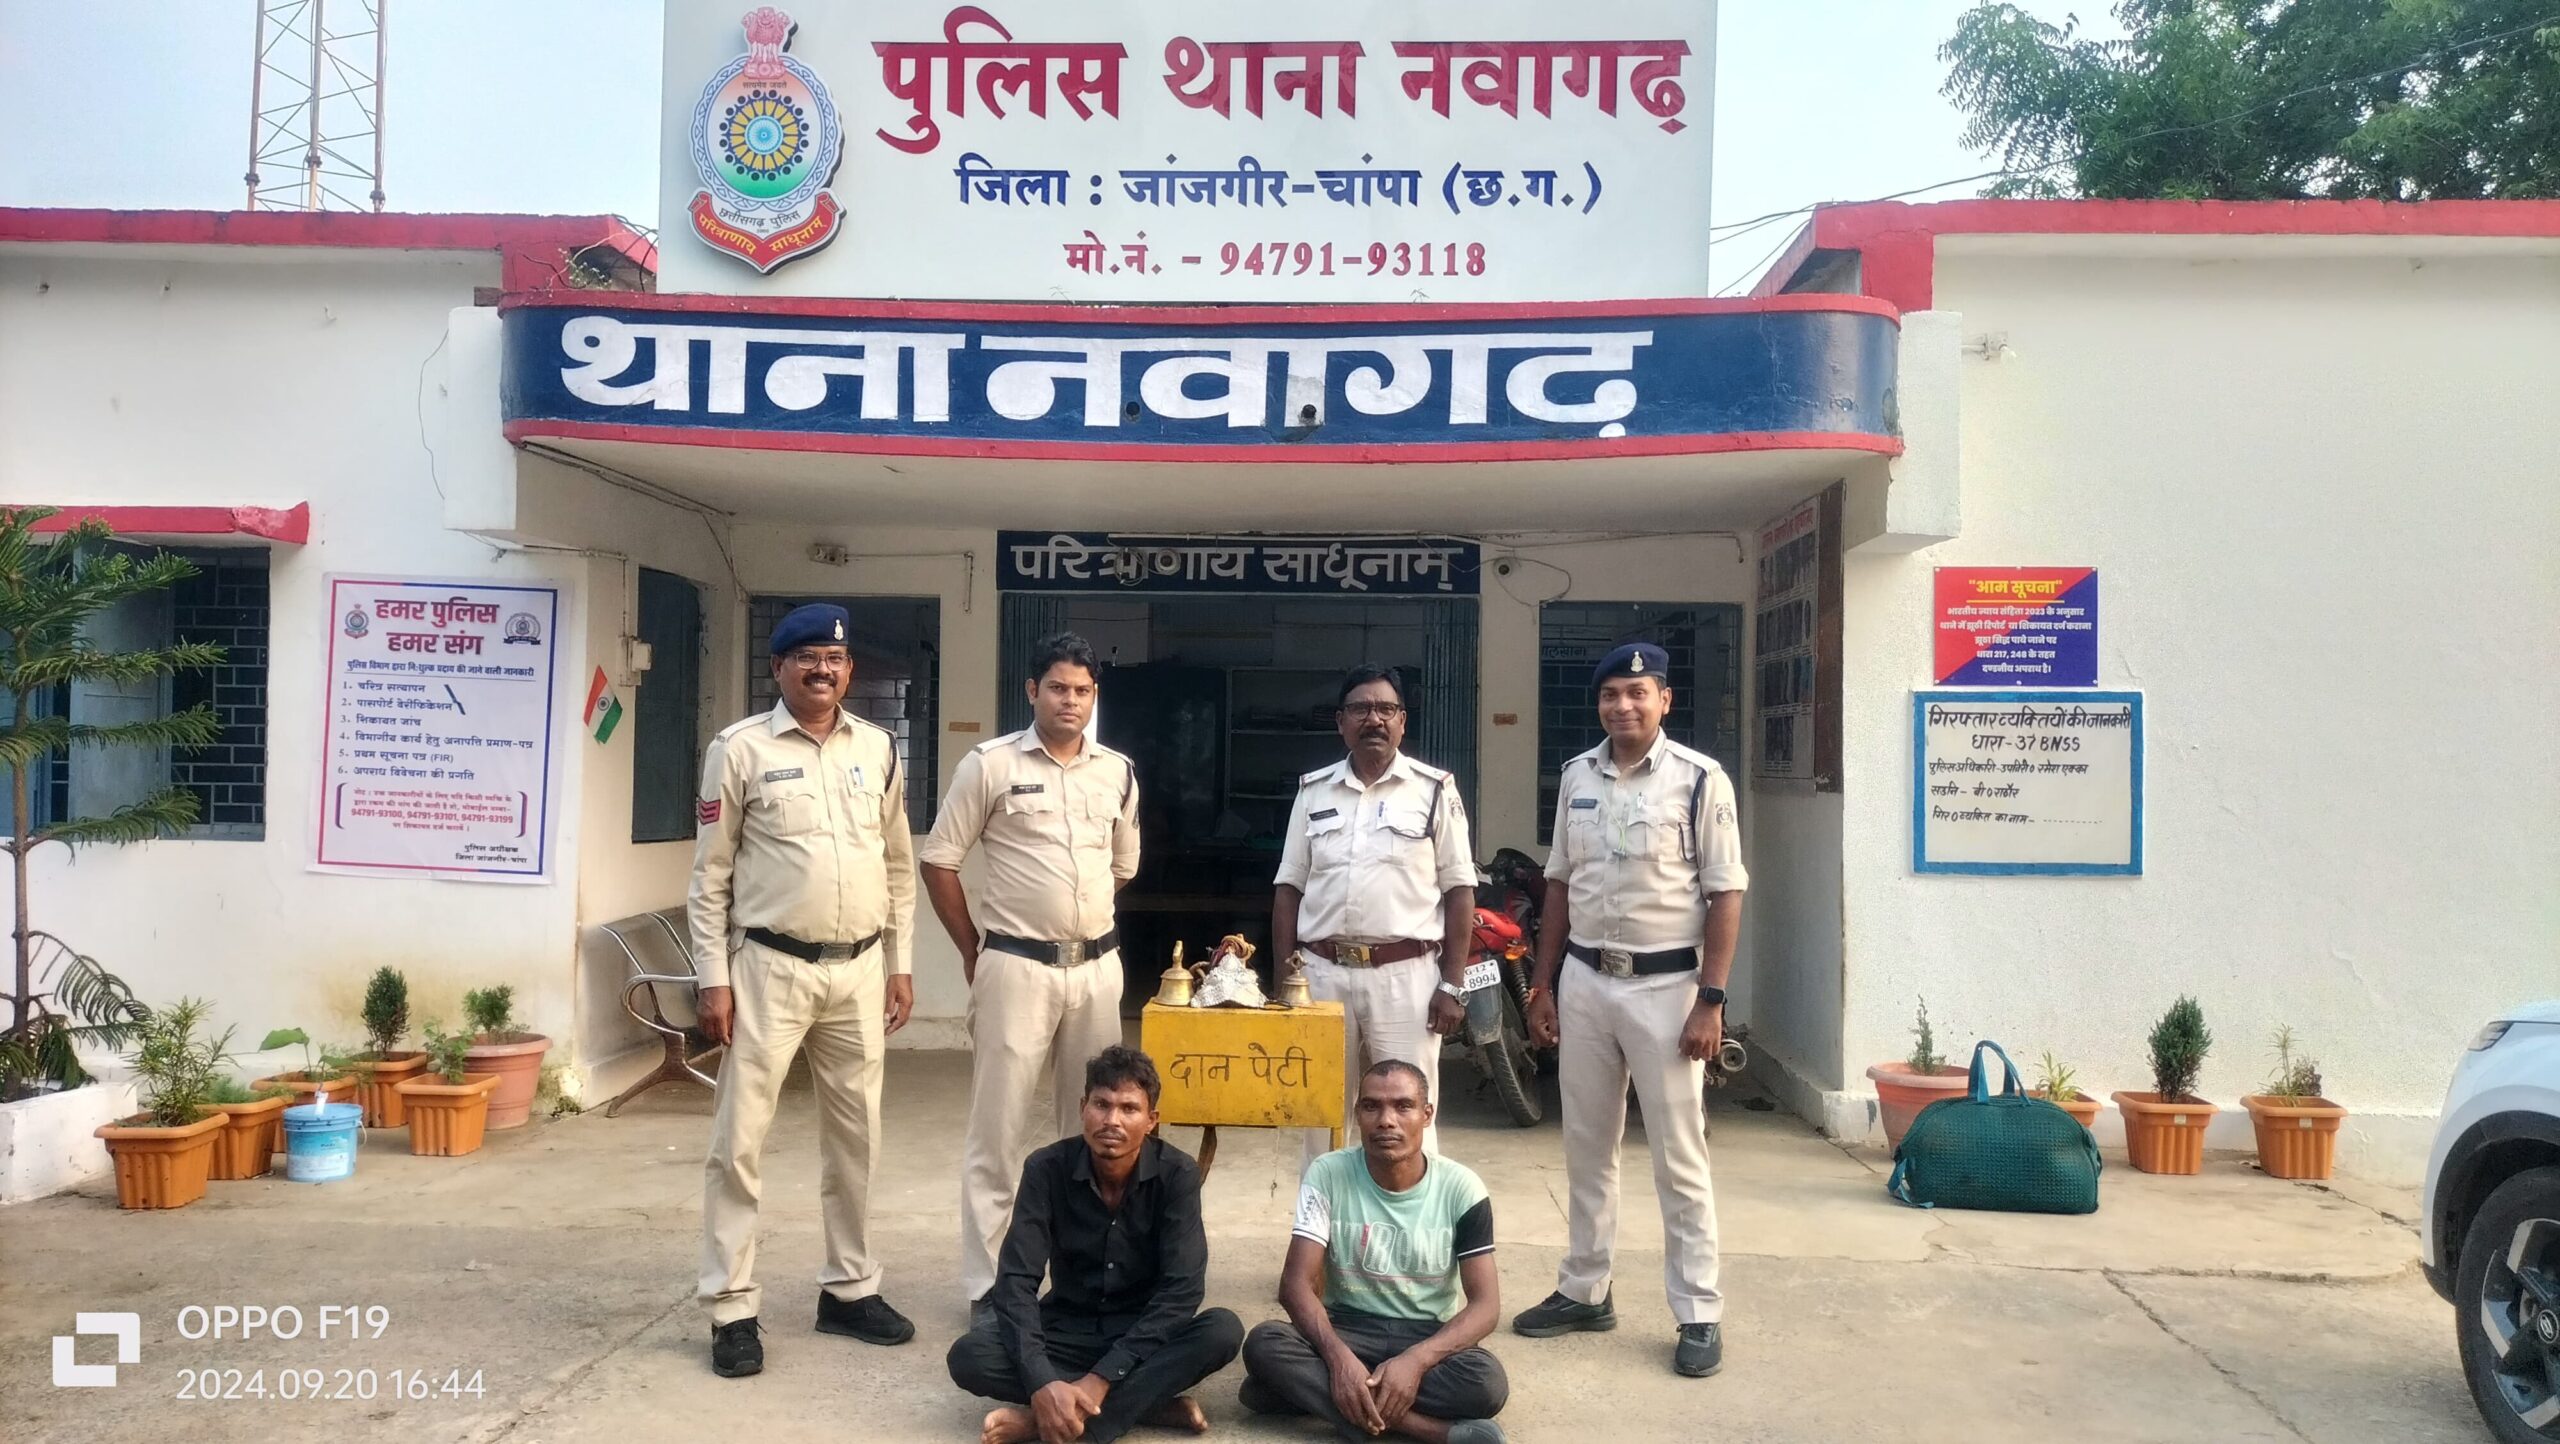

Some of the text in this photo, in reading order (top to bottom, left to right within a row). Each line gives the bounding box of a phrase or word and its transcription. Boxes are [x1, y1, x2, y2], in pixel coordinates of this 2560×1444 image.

[871, 5, 1692, 154] पुलिस थाना नवागढ़
[953, 152, 1070, 206] जिला
[1118, 153, 1422, 208] जांजगीर-चांपा
[1442, 161, 1602, 216] (छ.ग.)
[769, 210, 801, 229] पुलिस
[699, 214, 757, 255] परित्राणाय
[1063, 230, 1162, 275] मो.नं.
[1220, 242, 1486, 276] 94791-93118
[561, 316, 1654, 438] थाना नवागढ़
[1263, 543, 1464, 590] साधूनाम्
[374, 596, 499, 628] हमर पुलिस
[1947, 606, 1977, 615] भारतीय
[2000, 605, 2023, 616] संहिता
[2046, 606, 2055, 615] के
[2056, 608, 2085, 618] अनुसार
[1984, 620, 2006, 629] रिपोर्ट
[2019, 620, 2052, 630] शिकायत
[2066, 622, 2092, 630] कराना
[386, 632, 439, 653] हमर
[443, 630, 484, 655] संग
[2027, 634, 2045, 644] जाने
[2046, 636, 2057, 644] पर
[1994, 651, 2009, 659] 217,
[2028, 648, 2037, 658] के
[2038, 651, 2056, 659] तहत
[2015, 664, 2041, 672] अपराध
[358, 680, 383, 691] चरित्र
[387, 683, 426, 692] सत्यापन
[356, 697, 393, 708] पासपोर्ट
[356, 713, 397, 725] शिकायत
[400, 715, 422, 726] जांच
[1928, 704, 1999, 729] गिरफ्तार
[355, 730, 396, 742] विभागीय
[400, 733, 422, 743] कार्य
[426, 733, 440, 747] हेतु
[2040, 735, 2080, 752] BNSS
[354, 750, 376, 759] प्रथम
[380, 751, 409, 762] सूचना
[412, 752, 427, 761] पत्र
[431, 754, 454, 763] (FIR)
[353, 766, 387, 776] अपराध
[390, 766, 427, 778] विवेचना
[431, 768, 444, 778] की
[448, 769, 475, 780] प्रगति
[1469, 971, 1497, 989] 8994
[1170, 1053, 1240, 1089] दान
